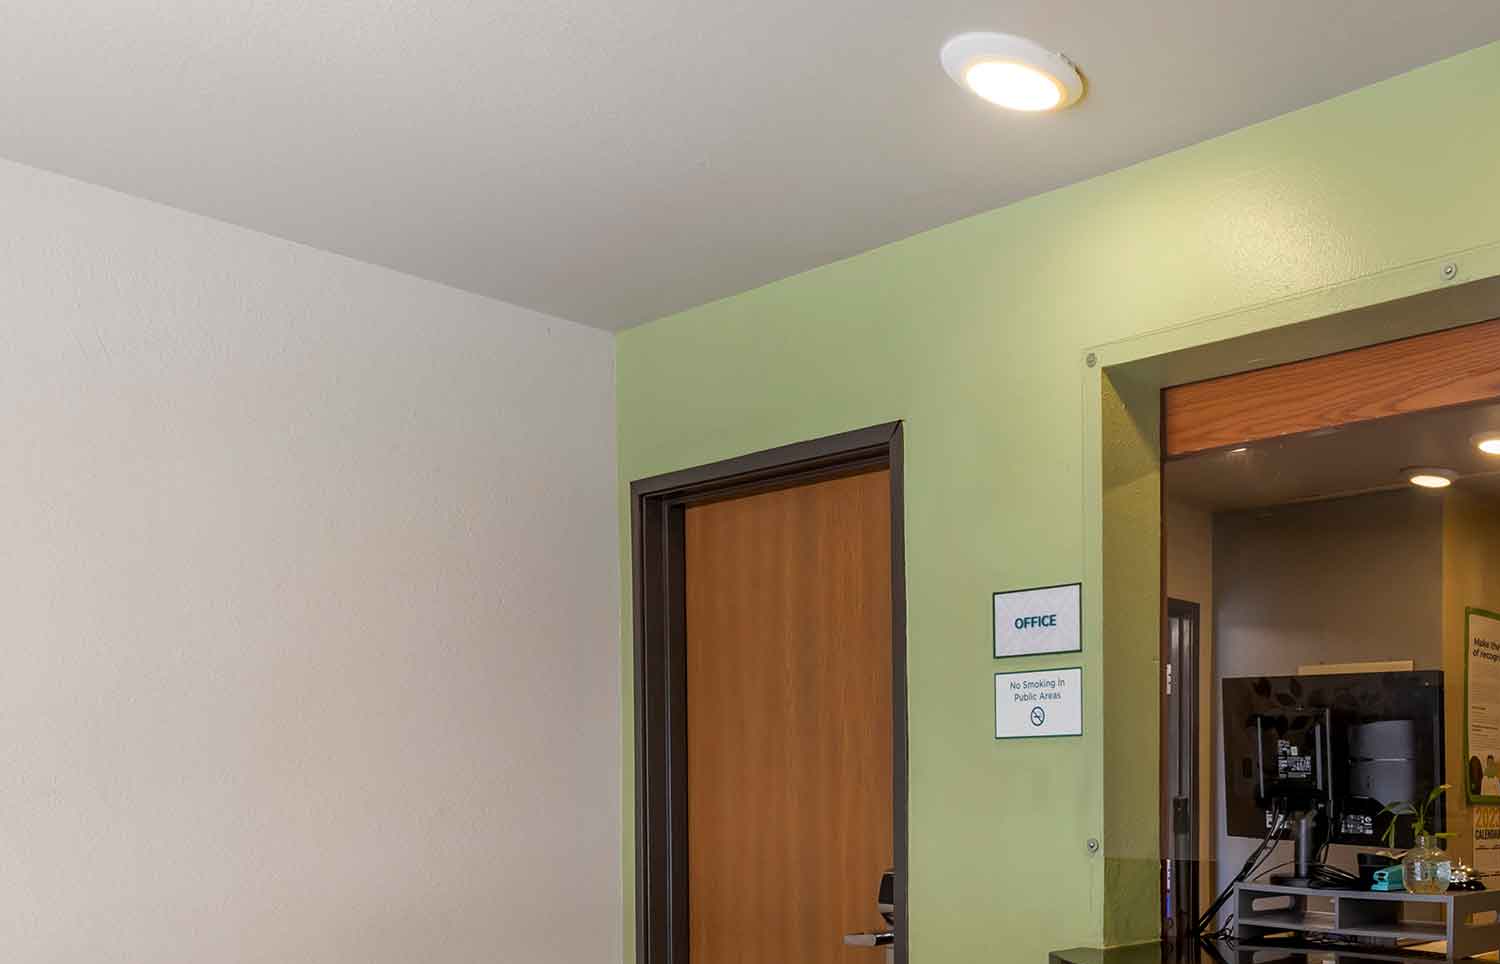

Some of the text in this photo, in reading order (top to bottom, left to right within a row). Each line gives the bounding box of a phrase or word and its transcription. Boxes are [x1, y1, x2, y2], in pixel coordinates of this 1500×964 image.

[1014, 614, 1057, 630] OFFICE
[1473, 637, 1489, 649] Make
[1490, 640, 1500, 652] the
[1472, 647, 1480, 657] of
[1010, 681, 1021, 690] No
[1022, 679, 1056, 689] Smoking
[1014, 691, 1061, 702] Public Areas
